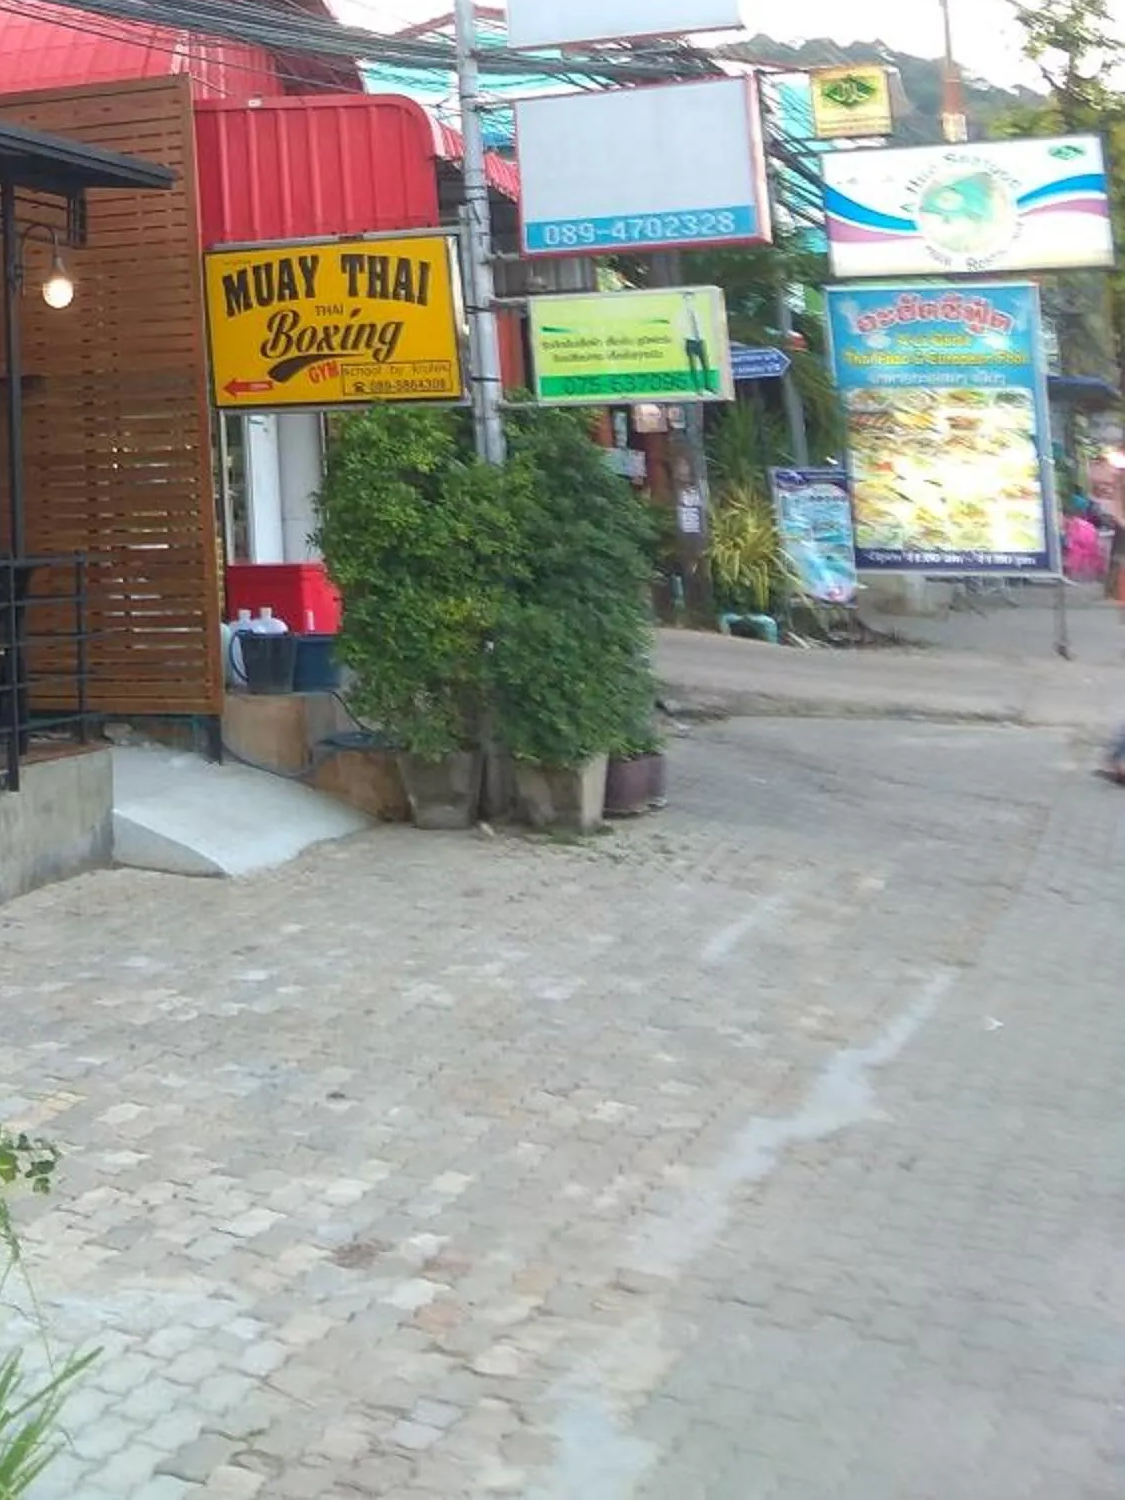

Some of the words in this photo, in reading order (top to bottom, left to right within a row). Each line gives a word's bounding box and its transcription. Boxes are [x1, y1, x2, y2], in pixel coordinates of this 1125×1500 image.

[543, 211, 736, 246] 089-4702328
[222, 254, 321, 318] MUAY
[341, 253, 432, 306] THAI
[315, 304, 344, 317] THAI
[260, 307, 405, 363] Boxing
[307, 359, 341, 385] GYM
